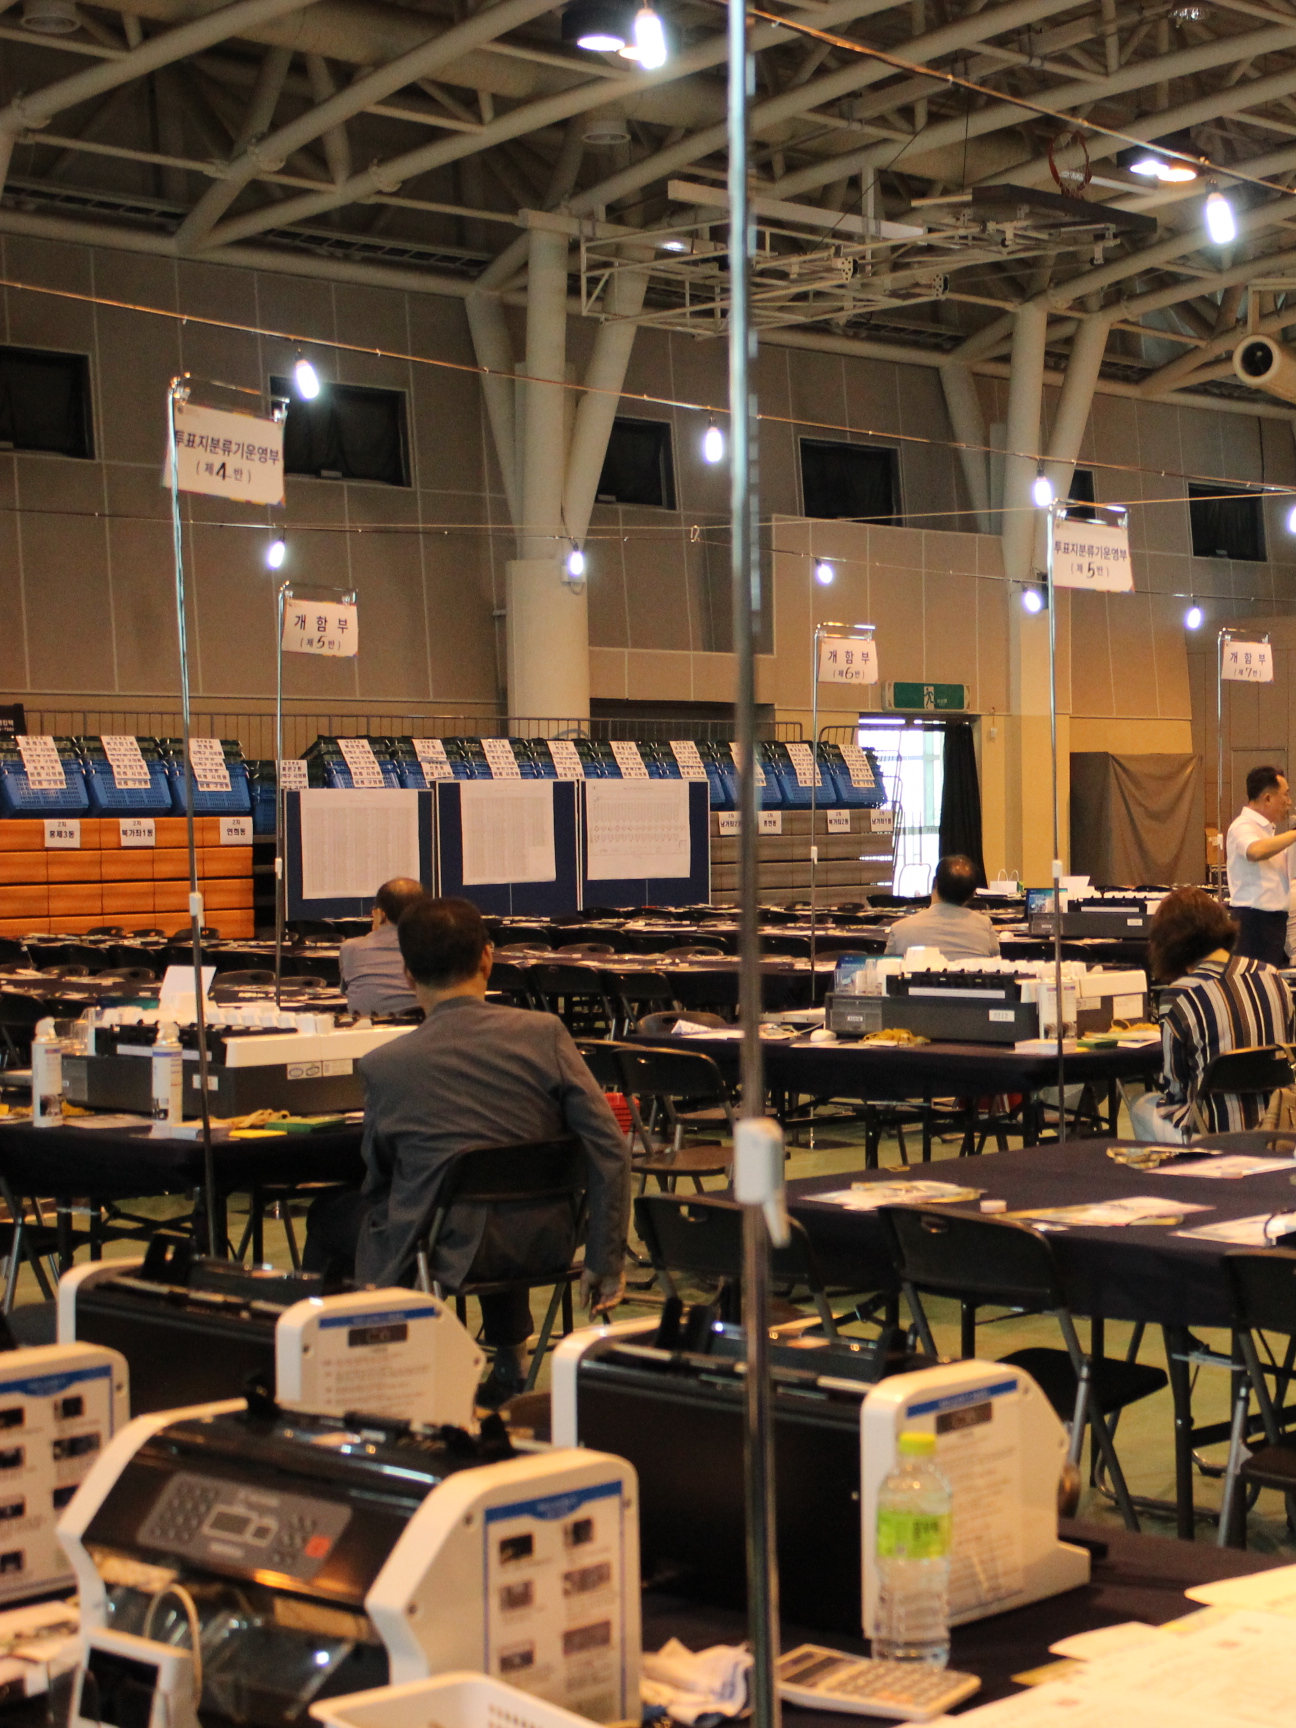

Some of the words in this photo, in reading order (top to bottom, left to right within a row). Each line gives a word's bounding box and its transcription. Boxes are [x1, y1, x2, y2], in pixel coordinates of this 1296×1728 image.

[175, 429, 280, 465] 투표지분류기운영부
[1054, 541, 1127, 561] 투표지분류기운영부
[49, 830, 75, 839] 홍제3동
[121, 829, 153, 838] 북가좌1동
[227, 828, 246, 836] 연희동
